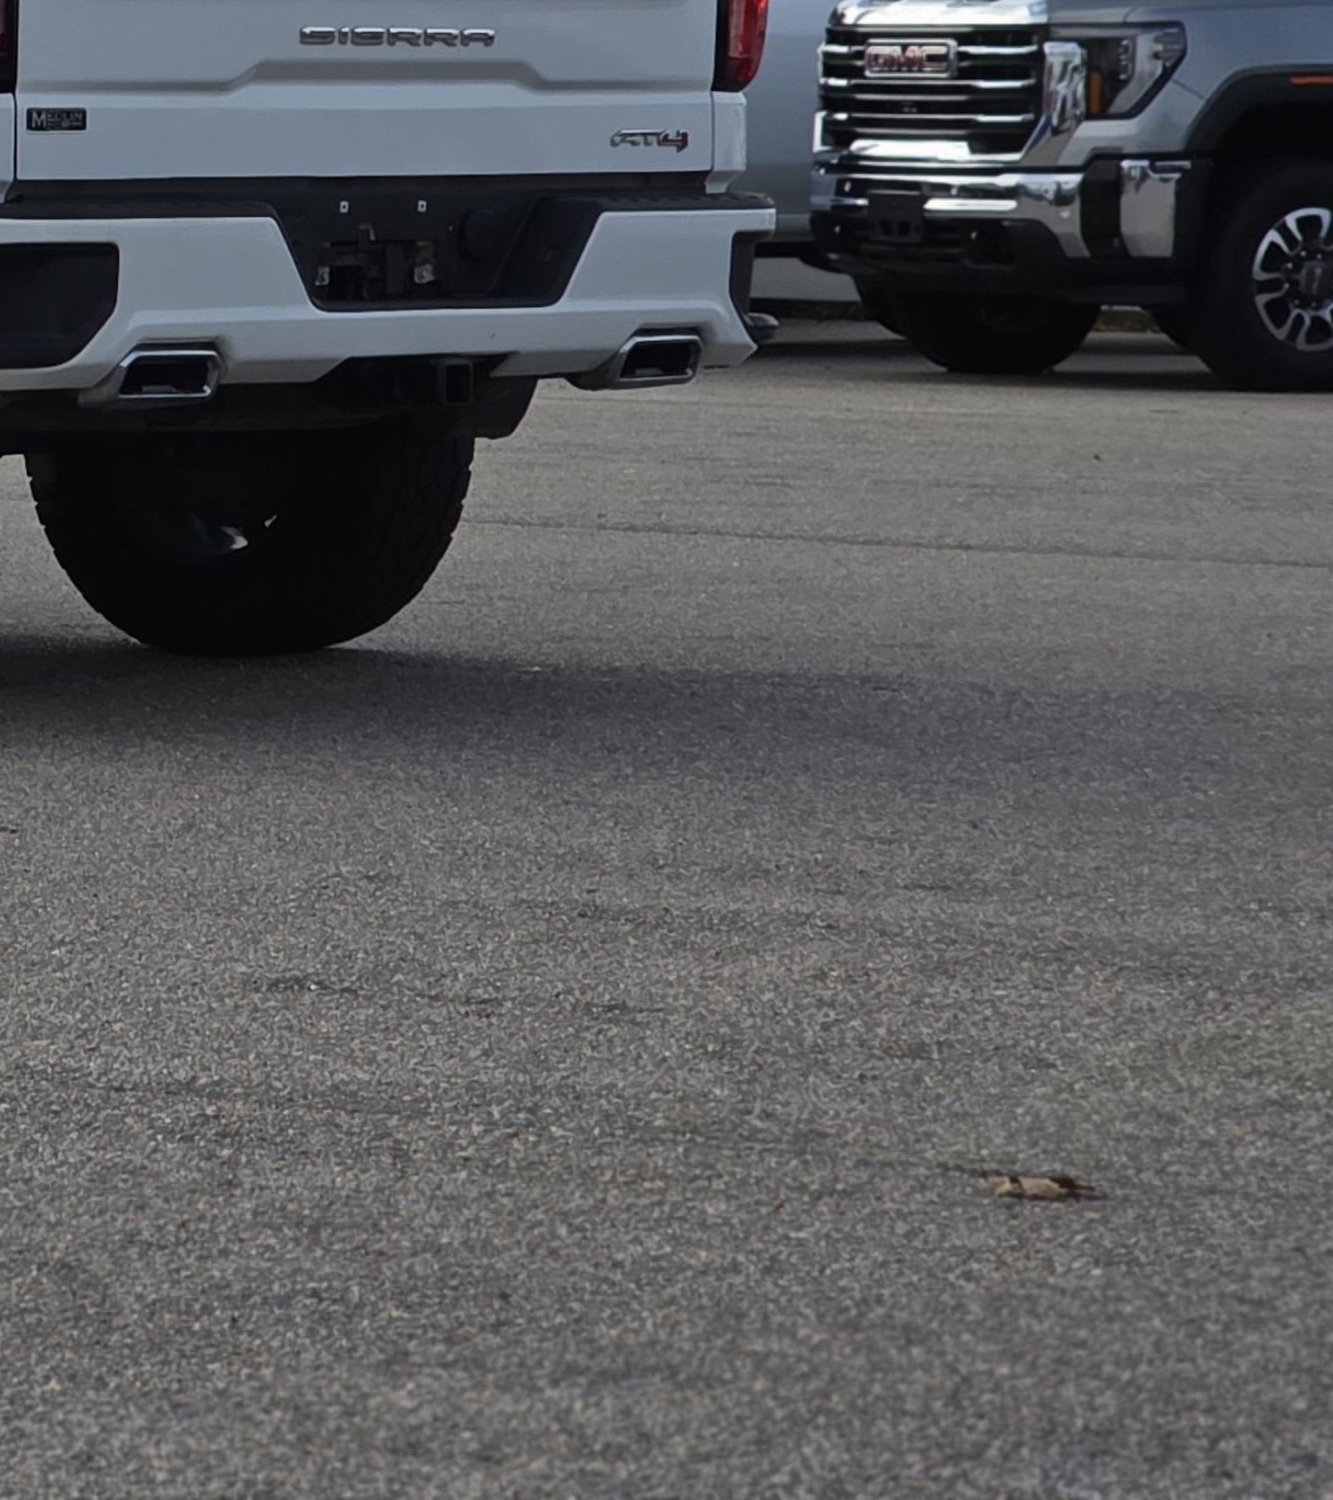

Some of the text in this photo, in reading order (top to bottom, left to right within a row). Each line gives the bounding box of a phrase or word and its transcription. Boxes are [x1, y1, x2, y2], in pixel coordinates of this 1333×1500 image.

[299, 26, 495, 46] SIERRA
[866, 45, 949, 71] GMC
[610, 128, 689, 153] AT4
